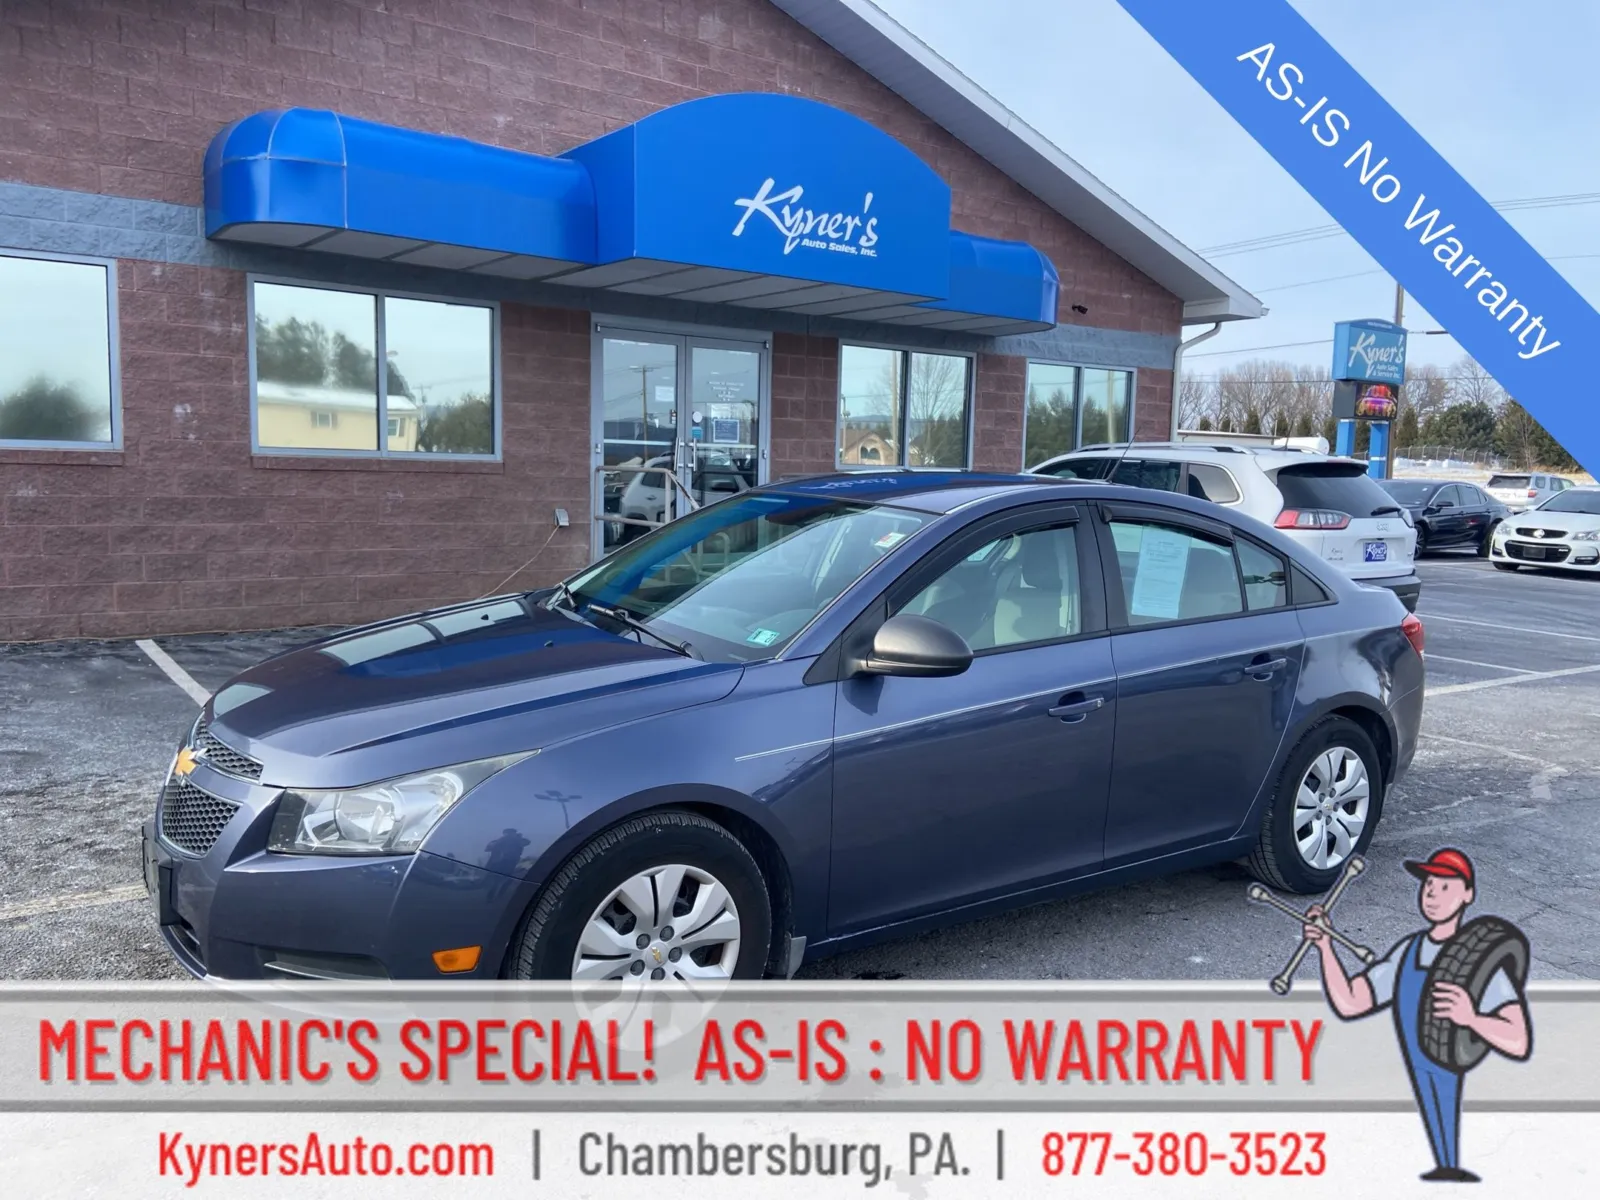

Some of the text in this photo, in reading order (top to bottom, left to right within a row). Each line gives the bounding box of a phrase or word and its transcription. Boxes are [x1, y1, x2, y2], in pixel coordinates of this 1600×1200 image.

[732, 177, 878, 255] Kyner's
[801, 238, 878, 257] Auto Sales, Inc.
[1348, 331, 1404, 378] Kyner's
